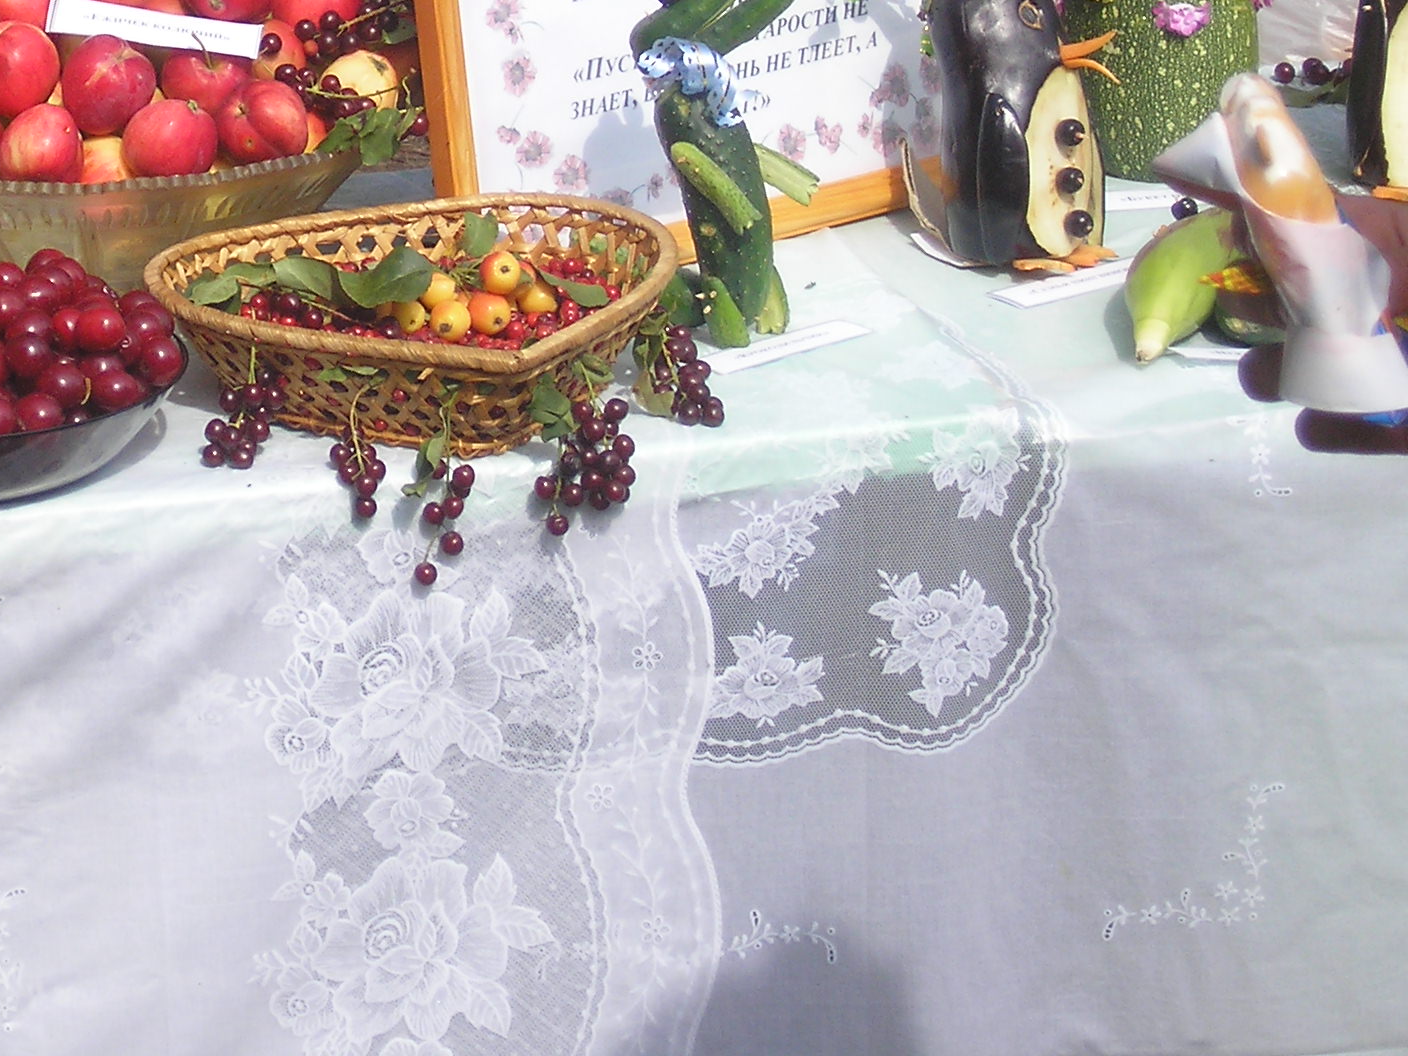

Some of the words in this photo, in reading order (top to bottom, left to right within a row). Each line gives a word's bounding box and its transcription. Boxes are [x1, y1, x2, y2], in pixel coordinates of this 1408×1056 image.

[570, 88, 638, 121] ЗНАЕТ,
[766, 51, 792, 73] НЕ
[798, 35, 861, 65] ТЛЕЕТ,
[866, 31, 878, 49] А
[573, 54, 637, 82] «ПУС
[755, 5, 838, 41] АРОСТИ
